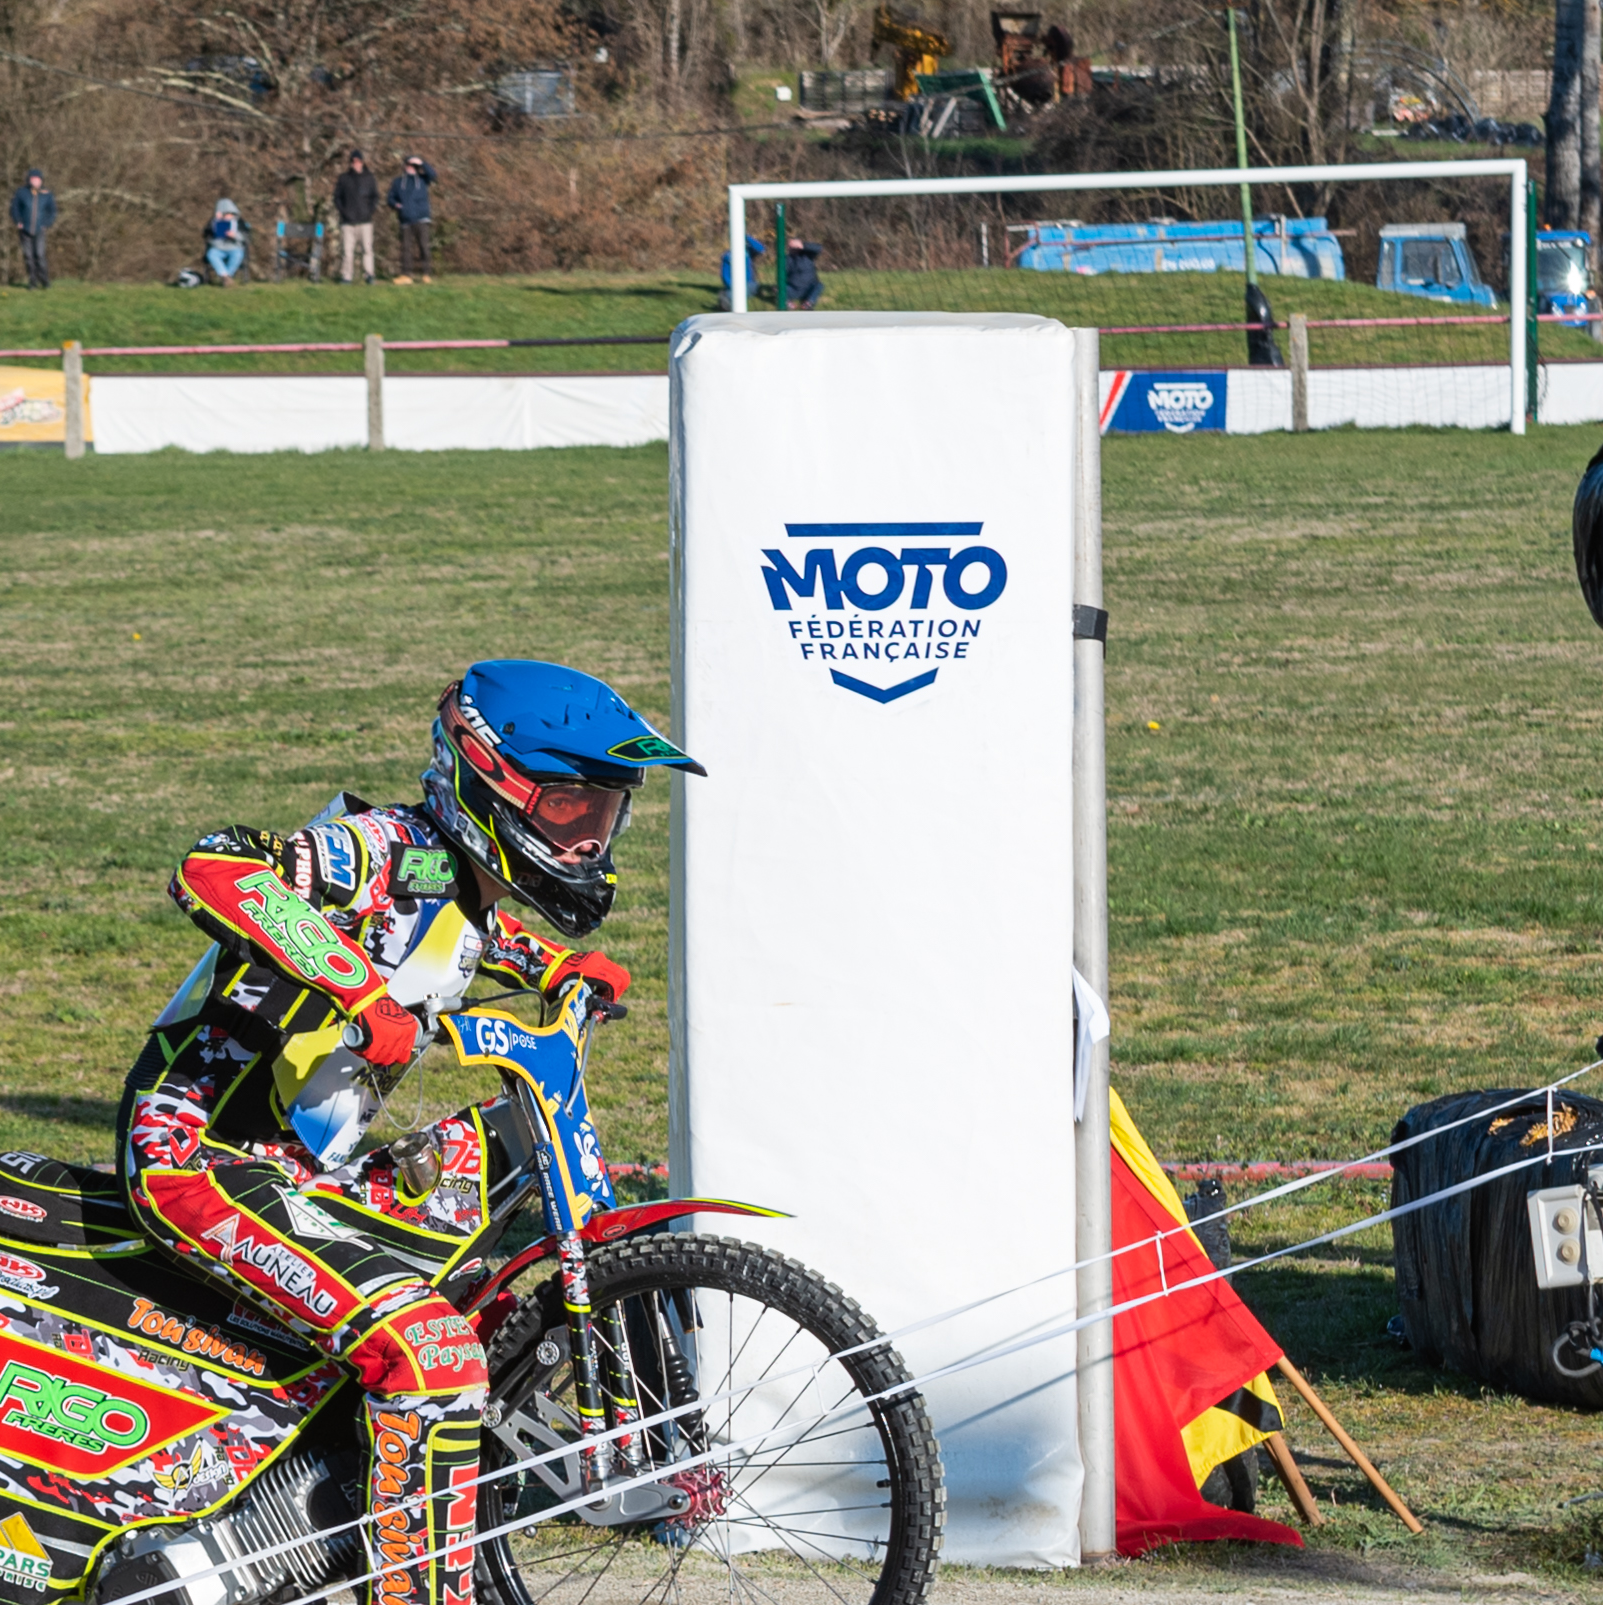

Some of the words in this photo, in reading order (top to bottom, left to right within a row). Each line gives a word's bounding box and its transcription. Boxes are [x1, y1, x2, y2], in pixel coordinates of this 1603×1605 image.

[1147, 389, 1214, 410] MOTO
[760, 545, 1008, 611] MOTO
[788, 614, 981, 639] FÉDÉRATION
[800, 641, 969, 663] FRANÇAISE
[236, 871, 368, 988] RIGO
[241, 901, 320, 980] FRERES
[475, 1017, 510, 1056] GS
[233, 1235, 338, 1318] AUNEAU
[5, 1410, 106, 1454] FRERES
